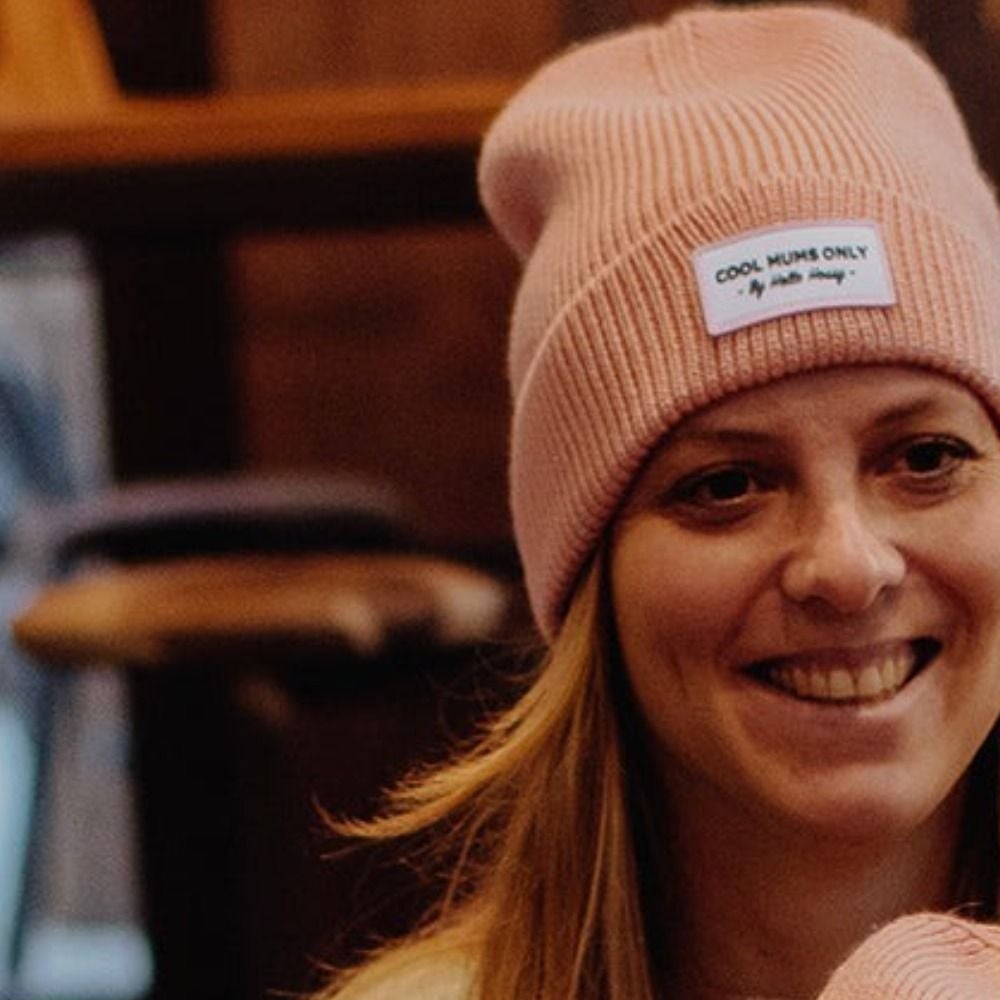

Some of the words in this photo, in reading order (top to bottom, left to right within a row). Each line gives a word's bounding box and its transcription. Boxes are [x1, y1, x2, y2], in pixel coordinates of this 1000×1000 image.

[715, 259, 763, 284] COOL
[766, 247, 819, 267] MUMS
[822, 245, 869, 261] ONLY
